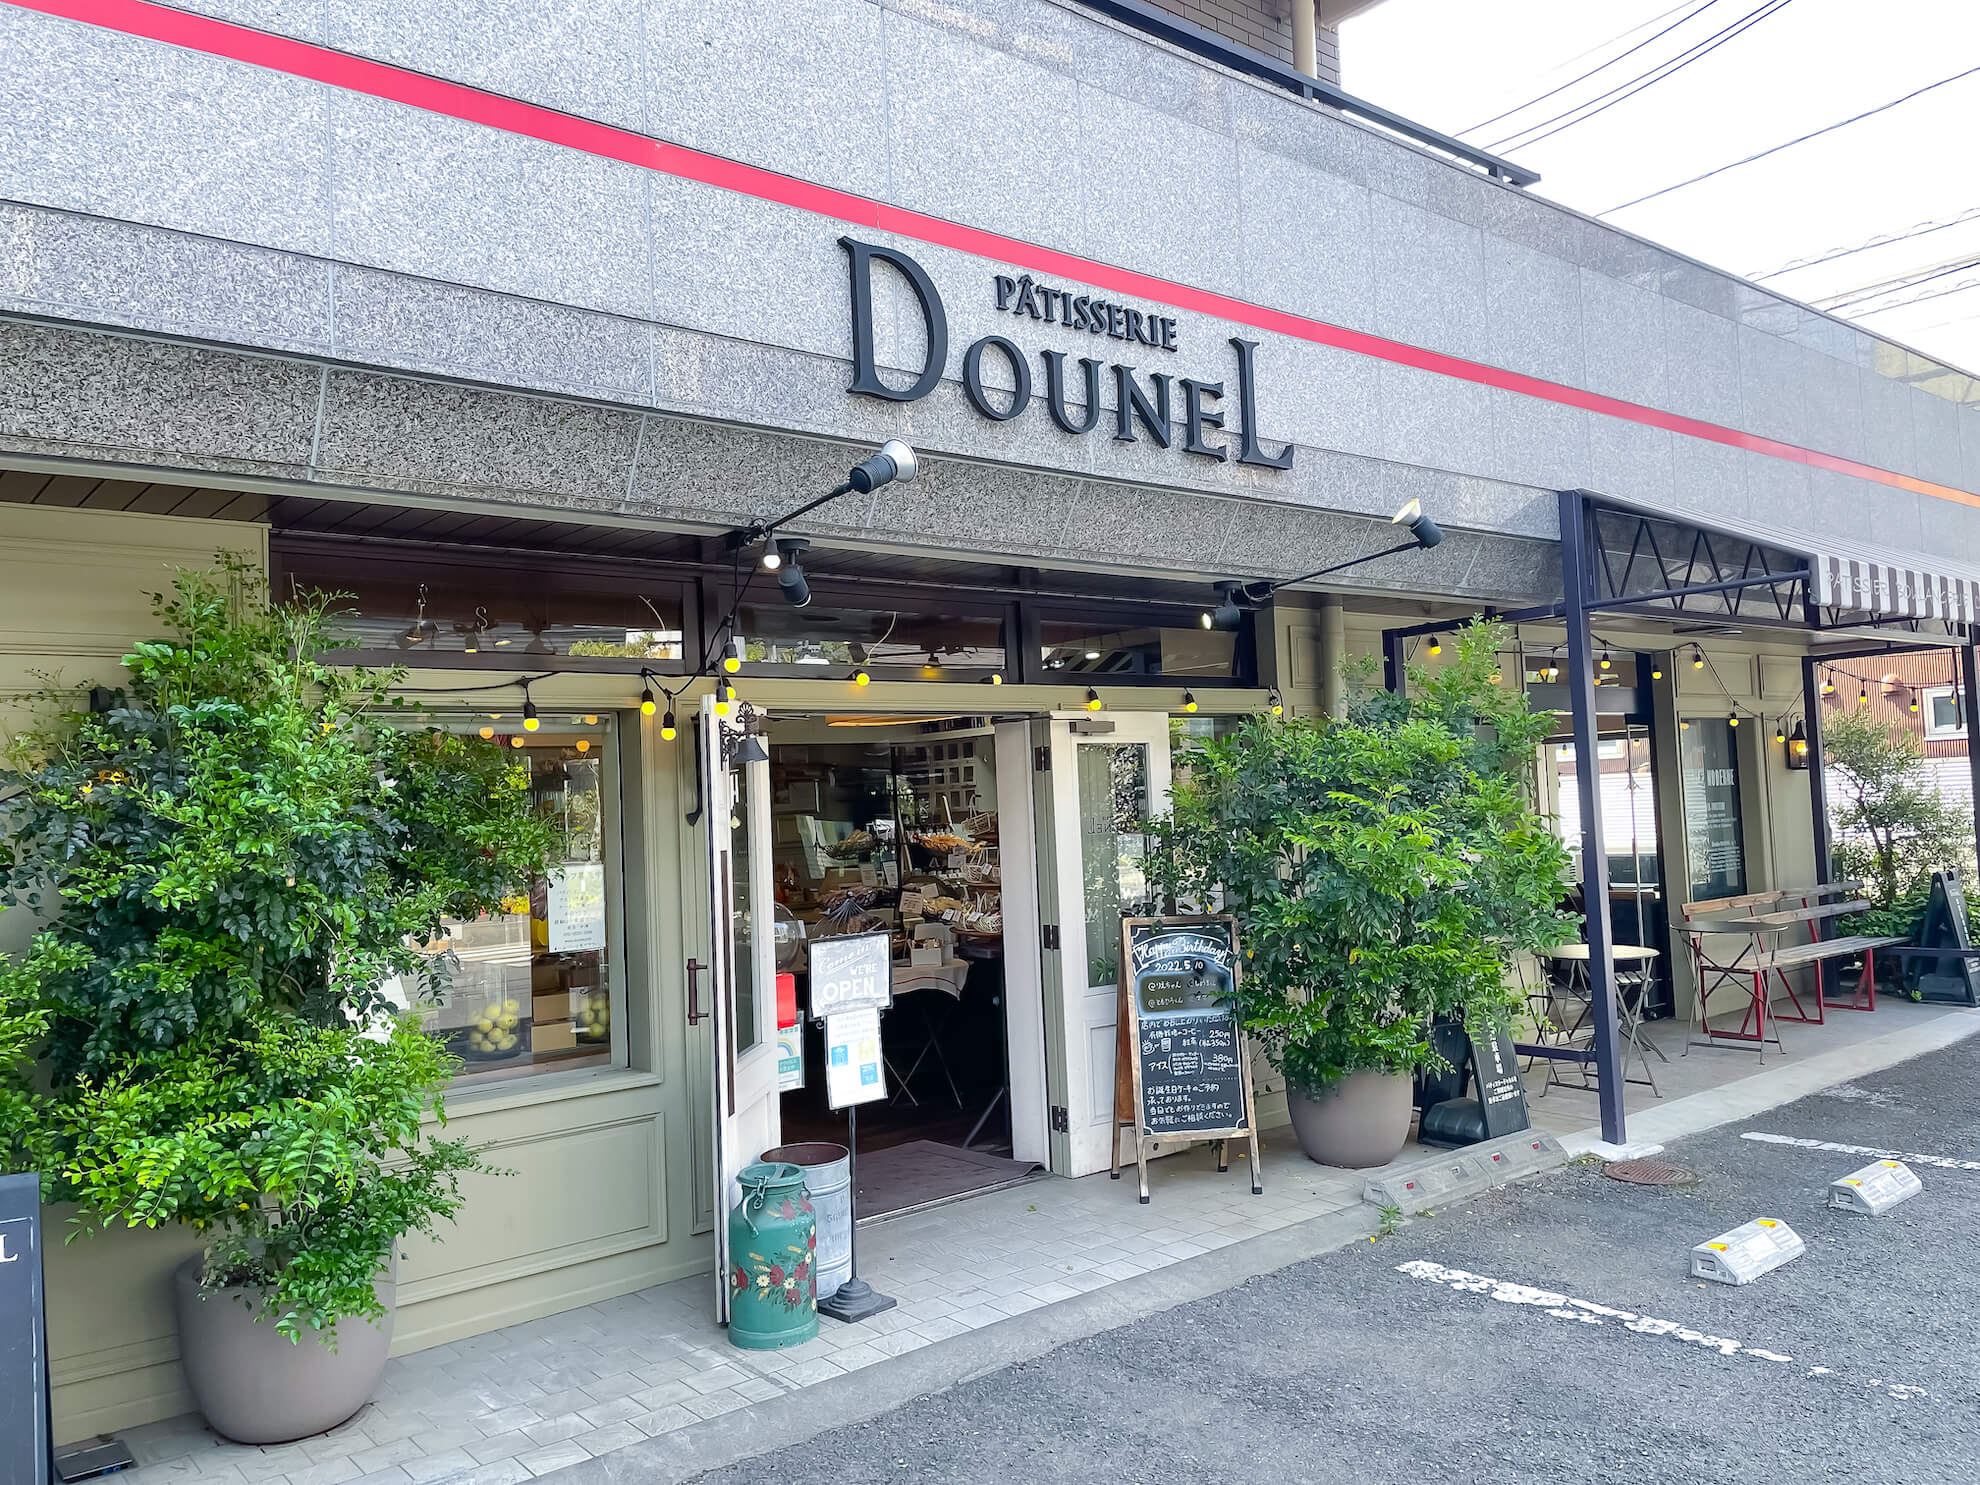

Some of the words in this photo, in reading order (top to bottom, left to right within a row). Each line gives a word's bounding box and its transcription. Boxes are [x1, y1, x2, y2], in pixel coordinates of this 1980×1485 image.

[994, 273, 1177, 352] PÂTISSERIE
[837, 235, 1294, 470] DOUNEL
[1172, 936, 1228, 963] Birthday
[1155, 959, 1204, 972] 2022.5.10
[823, 975, 875, 1001] OPEN
[1148, 1061, 1168, 1072] アイス
